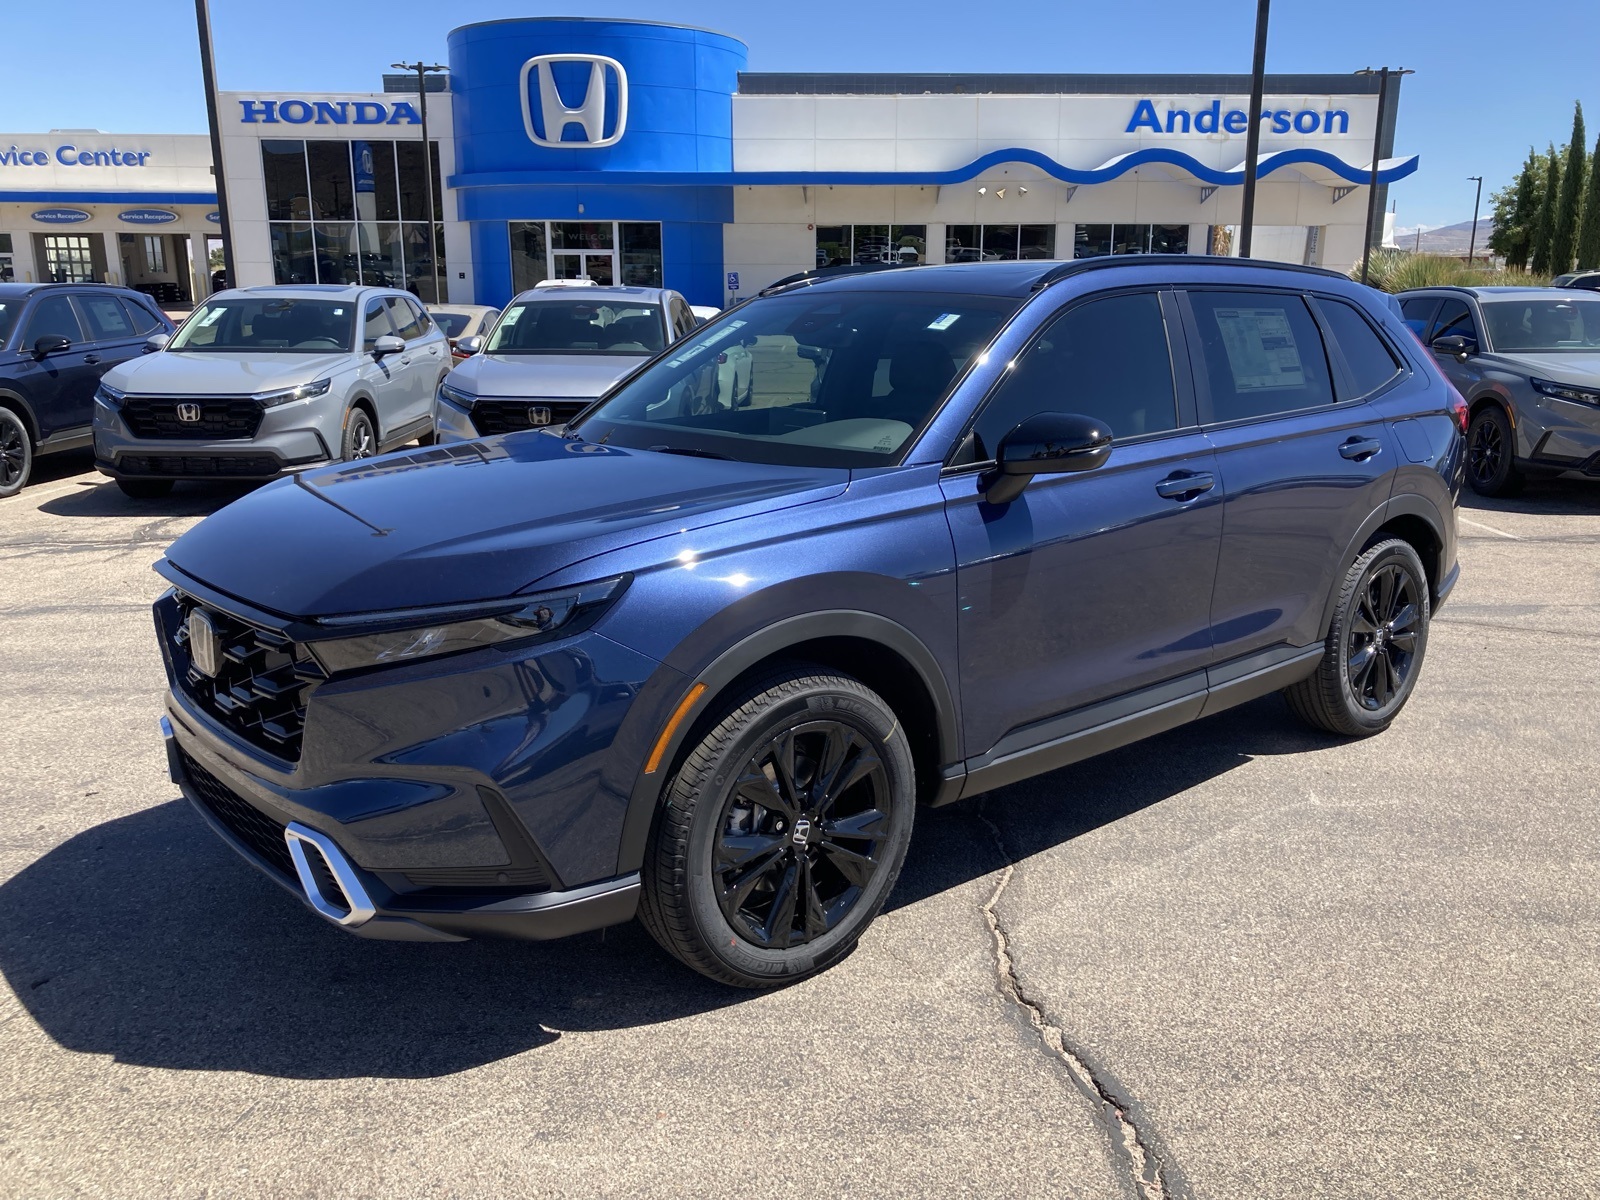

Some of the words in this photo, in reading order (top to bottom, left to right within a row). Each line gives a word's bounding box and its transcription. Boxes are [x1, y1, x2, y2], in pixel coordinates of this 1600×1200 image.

[239, 100, 422, 124] HONDA
[1125, 99, 1349, 134] Anderson
[56, 145, 149, 166] Center
[568, 233, 614, 241] WELCOM
